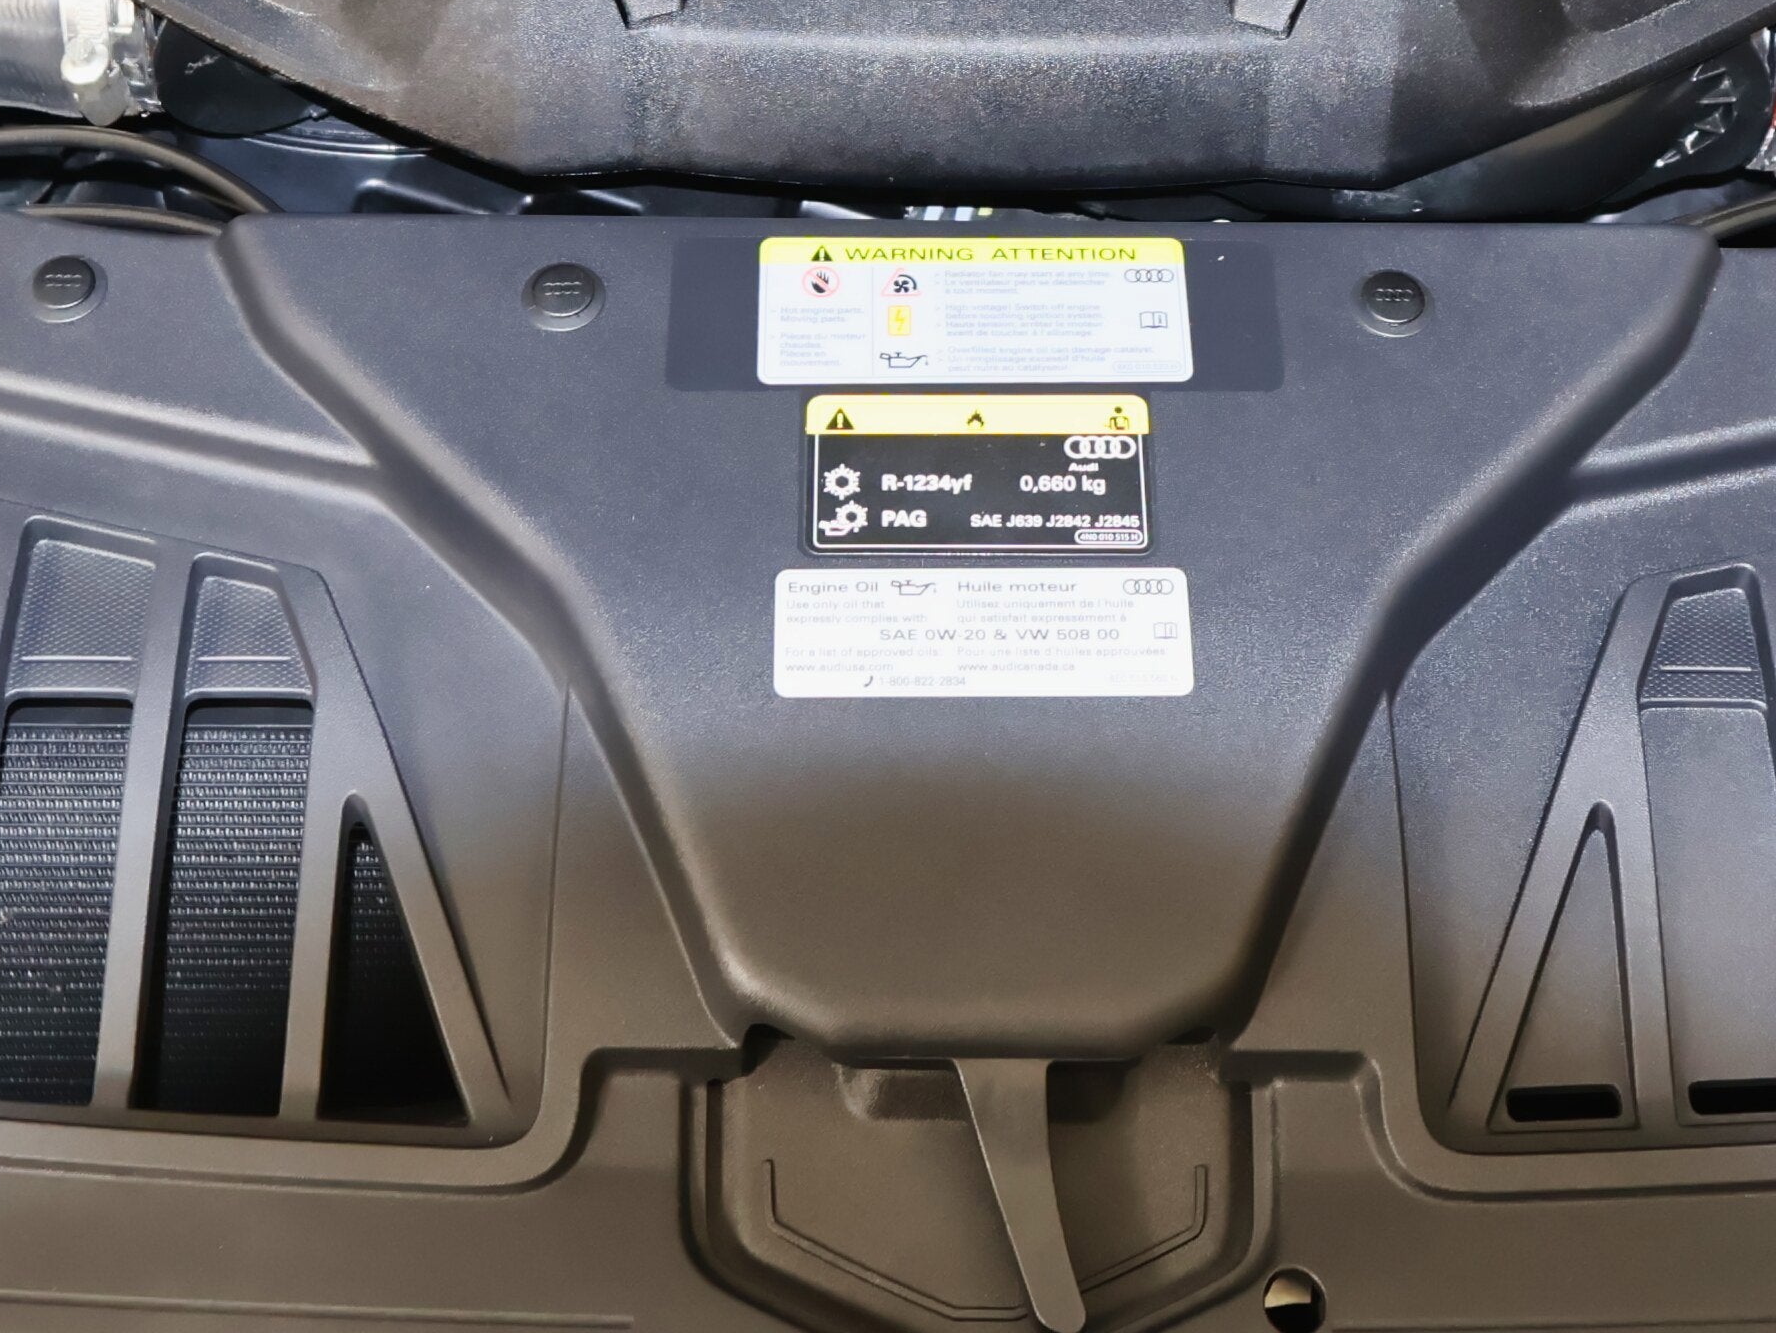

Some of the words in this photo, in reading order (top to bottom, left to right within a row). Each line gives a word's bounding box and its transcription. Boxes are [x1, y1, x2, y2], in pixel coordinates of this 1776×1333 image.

[845, 248, 974, 261] WARNING
[991, 248, 1137, 261] ATTENTION
[803, 307, 834, 316] engine
[1067, 304, 1100, 312] engine
[977, 312, 1023, 321] touching
[1027, 312, 1063, 321] ignition
[948, 346, 996, 354] Overfilled
[999, 347, 1033, 355] engine
[1071, 346, 1112, 355] damage
[1068, 462, 1099, 472] Audi
[881, 474, 973, 494] R-1234yf
[1019, 475, 1077, 494] 0,660
[1081, 475, 1106, 495] kg
[881, 510, 927, 527] PAG
[970, 514, 1002, 527] SAE
[1006, 514, 1042, 527] J639
[1046, 514, 1091, 527] J2842
[1095, 514, 1140, 527] J2845
[788, 581, 848, 595] Engine
[855, 581, 879, 593] Oil
[957, 581, 1002, 592] Huile
[1009, 582, 1077, 592] moteur
[786, 600, 809, 609] Use
[813, 600, 839, 611] only
[842, 600, 857, 609] oil
[862, 600, 885, 609] that
[957, 599, 1000, 609] Utilisez
[1005, 599, 1075, 610] uniquement
[1080, 599, 1094, 608] de
[786, 614, 841, 624] expressly
[845, 614, 898, 624] complies
[902, 613, 928, 623] with
[957, 613, 977, 624] qui
[980, 613, 1027, 623] satisfait
[880, 629, 917, 641] SAE
[994, 629, 1007, 641] &
[1016, 629, 1050, 641] VW
[1057, 629, 1090, 641] 508
[1097, 629, 1120, 641] 00
[785, 647, 806, 657] For
[819, 647, 836, 657] list
[841, 647, 853, 657] of
[857, 647, 913, 658] approved
[957, 646, 985, 656] Pour
[990, 647, 1011, 656] une
[1015, 646, 1040, 656] liste
[786, 663, 893, 672] www.audiusa.com
[957, 662, 1075, 672] www.audicanada.ca
